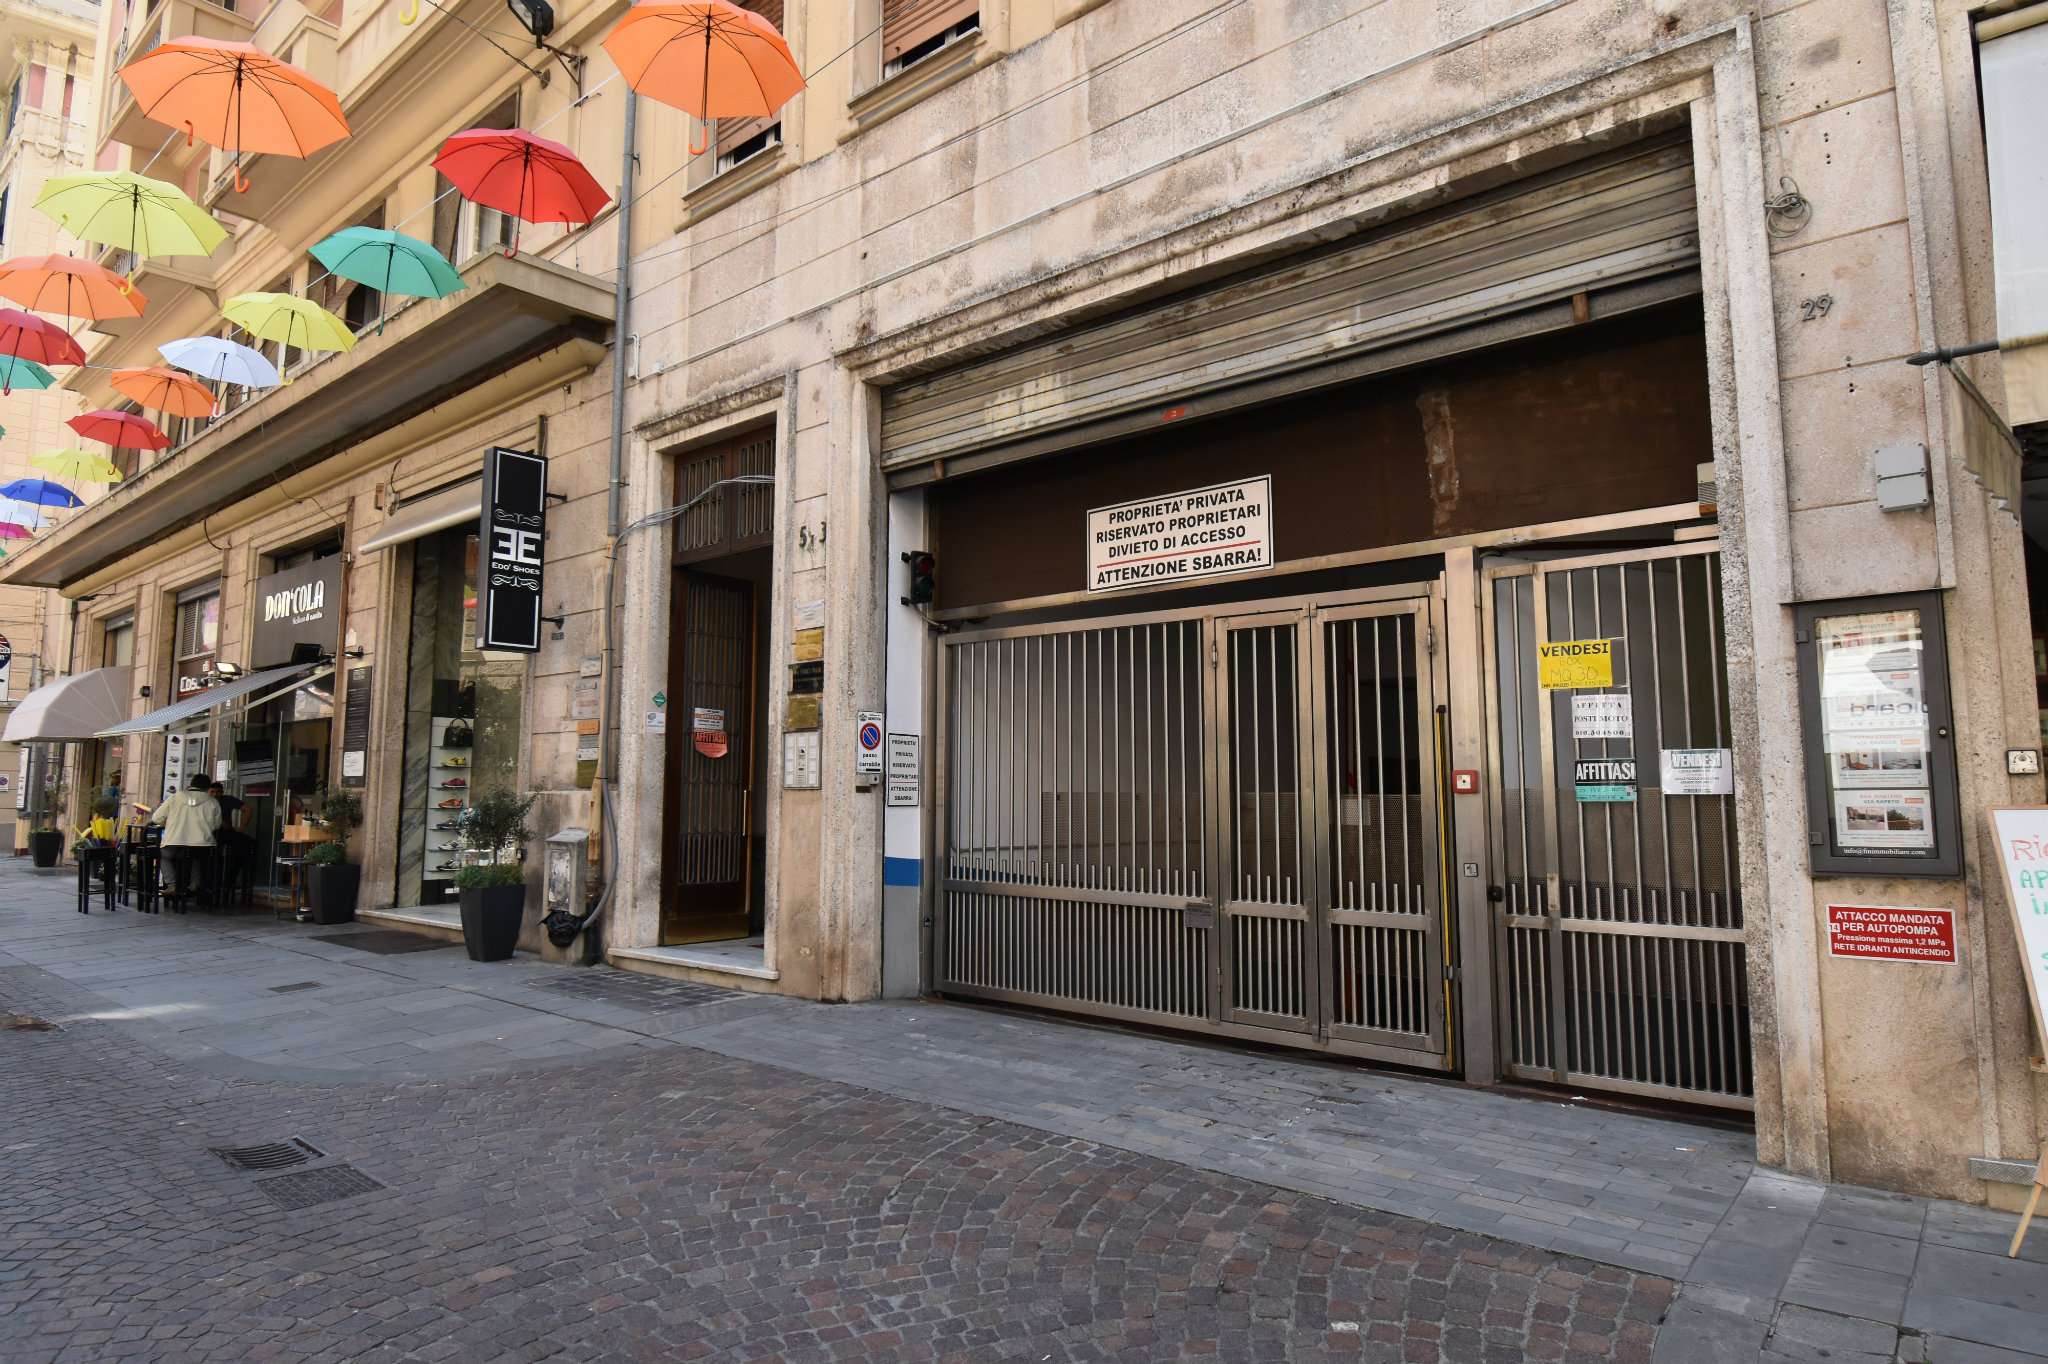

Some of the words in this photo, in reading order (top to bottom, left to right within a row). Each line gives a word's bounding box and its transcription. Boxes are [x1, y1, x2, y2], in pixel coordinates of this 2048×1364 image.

[1800, 292, 1833, 321] 29
[1109, 500, 1183, 524] PROPRIETA'
[1187, 489, 1245, 511] PRIVATA
[1096, 521, 1165, 544] RISERVATO
[1169, 503, 1261, 531] PROPRIETARI
[1109, 539, 1159, 558] DIVIETO
[1163, 536, 1176, 549] DI
[1181, 525, 1246, 547] ACCESSO
[1097, 559, 1187, 585] ATTENZIONE
[1192, 548, 1261, 571] SBARRA!
[1540, 642, 1609, 658] VENDESI
[1575, 762, 1636, 780] AFFITTASI
[1835, 911, 1887, 922] ATTACCO
[1889, 913, 1945, 925] MANDATA
[1842, 922, 1865, 932] PER
[1867, 924, 1938, 936] AUTOPOMPA
[1837, 933, 1876, 943] Pressione
[1877, 936, 1913, 945] massima
[1927, 938, 1946, 946] MPa
[1834, 942, 1858, 951] RETE
[1857, 944, 1891, 953] IDRANTI
[1892, 947, 1951, 957] ANTINCENDIO
